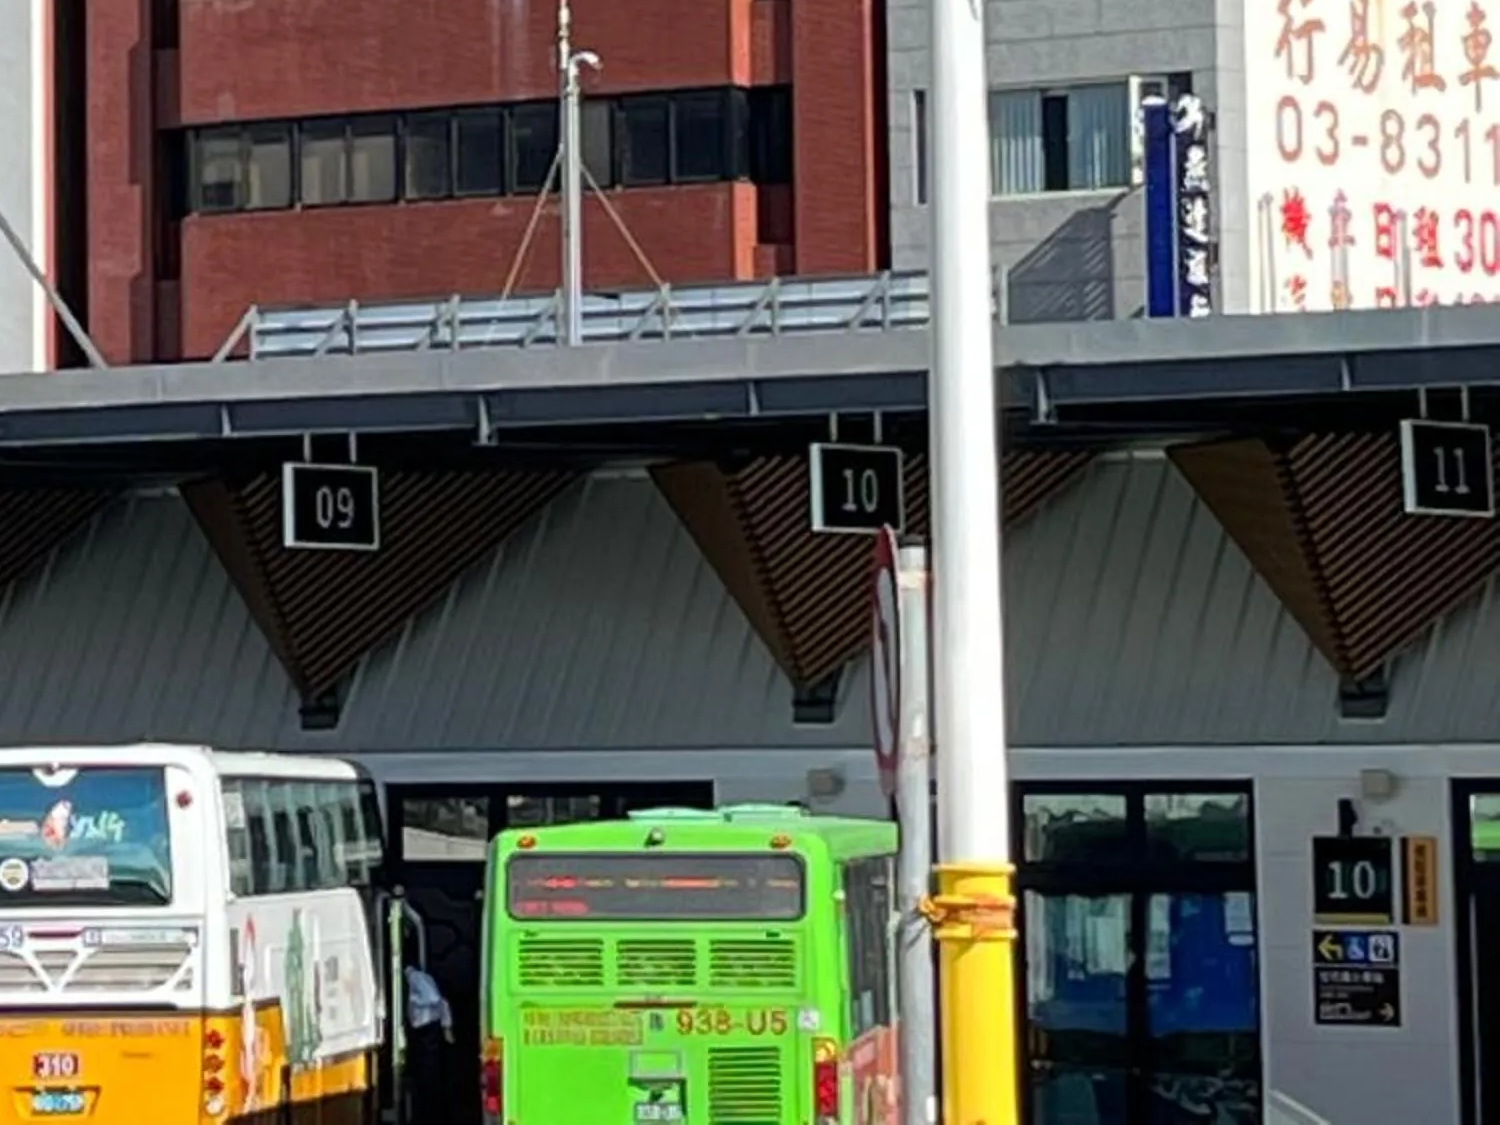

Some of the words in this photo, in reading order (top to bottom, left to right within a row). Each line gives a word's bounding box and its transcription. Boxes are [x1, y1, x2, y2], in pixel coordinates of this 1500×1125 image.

[1432, 445, 1471, 494] 11
[315, 486, 356, 529] 09
[841, 469, 879, 513] 10
[1326, 860, 1378, 901] 10
[675, 1008, 789, 1037] 938-U5
[37, 1053, 76, 1077] 310
